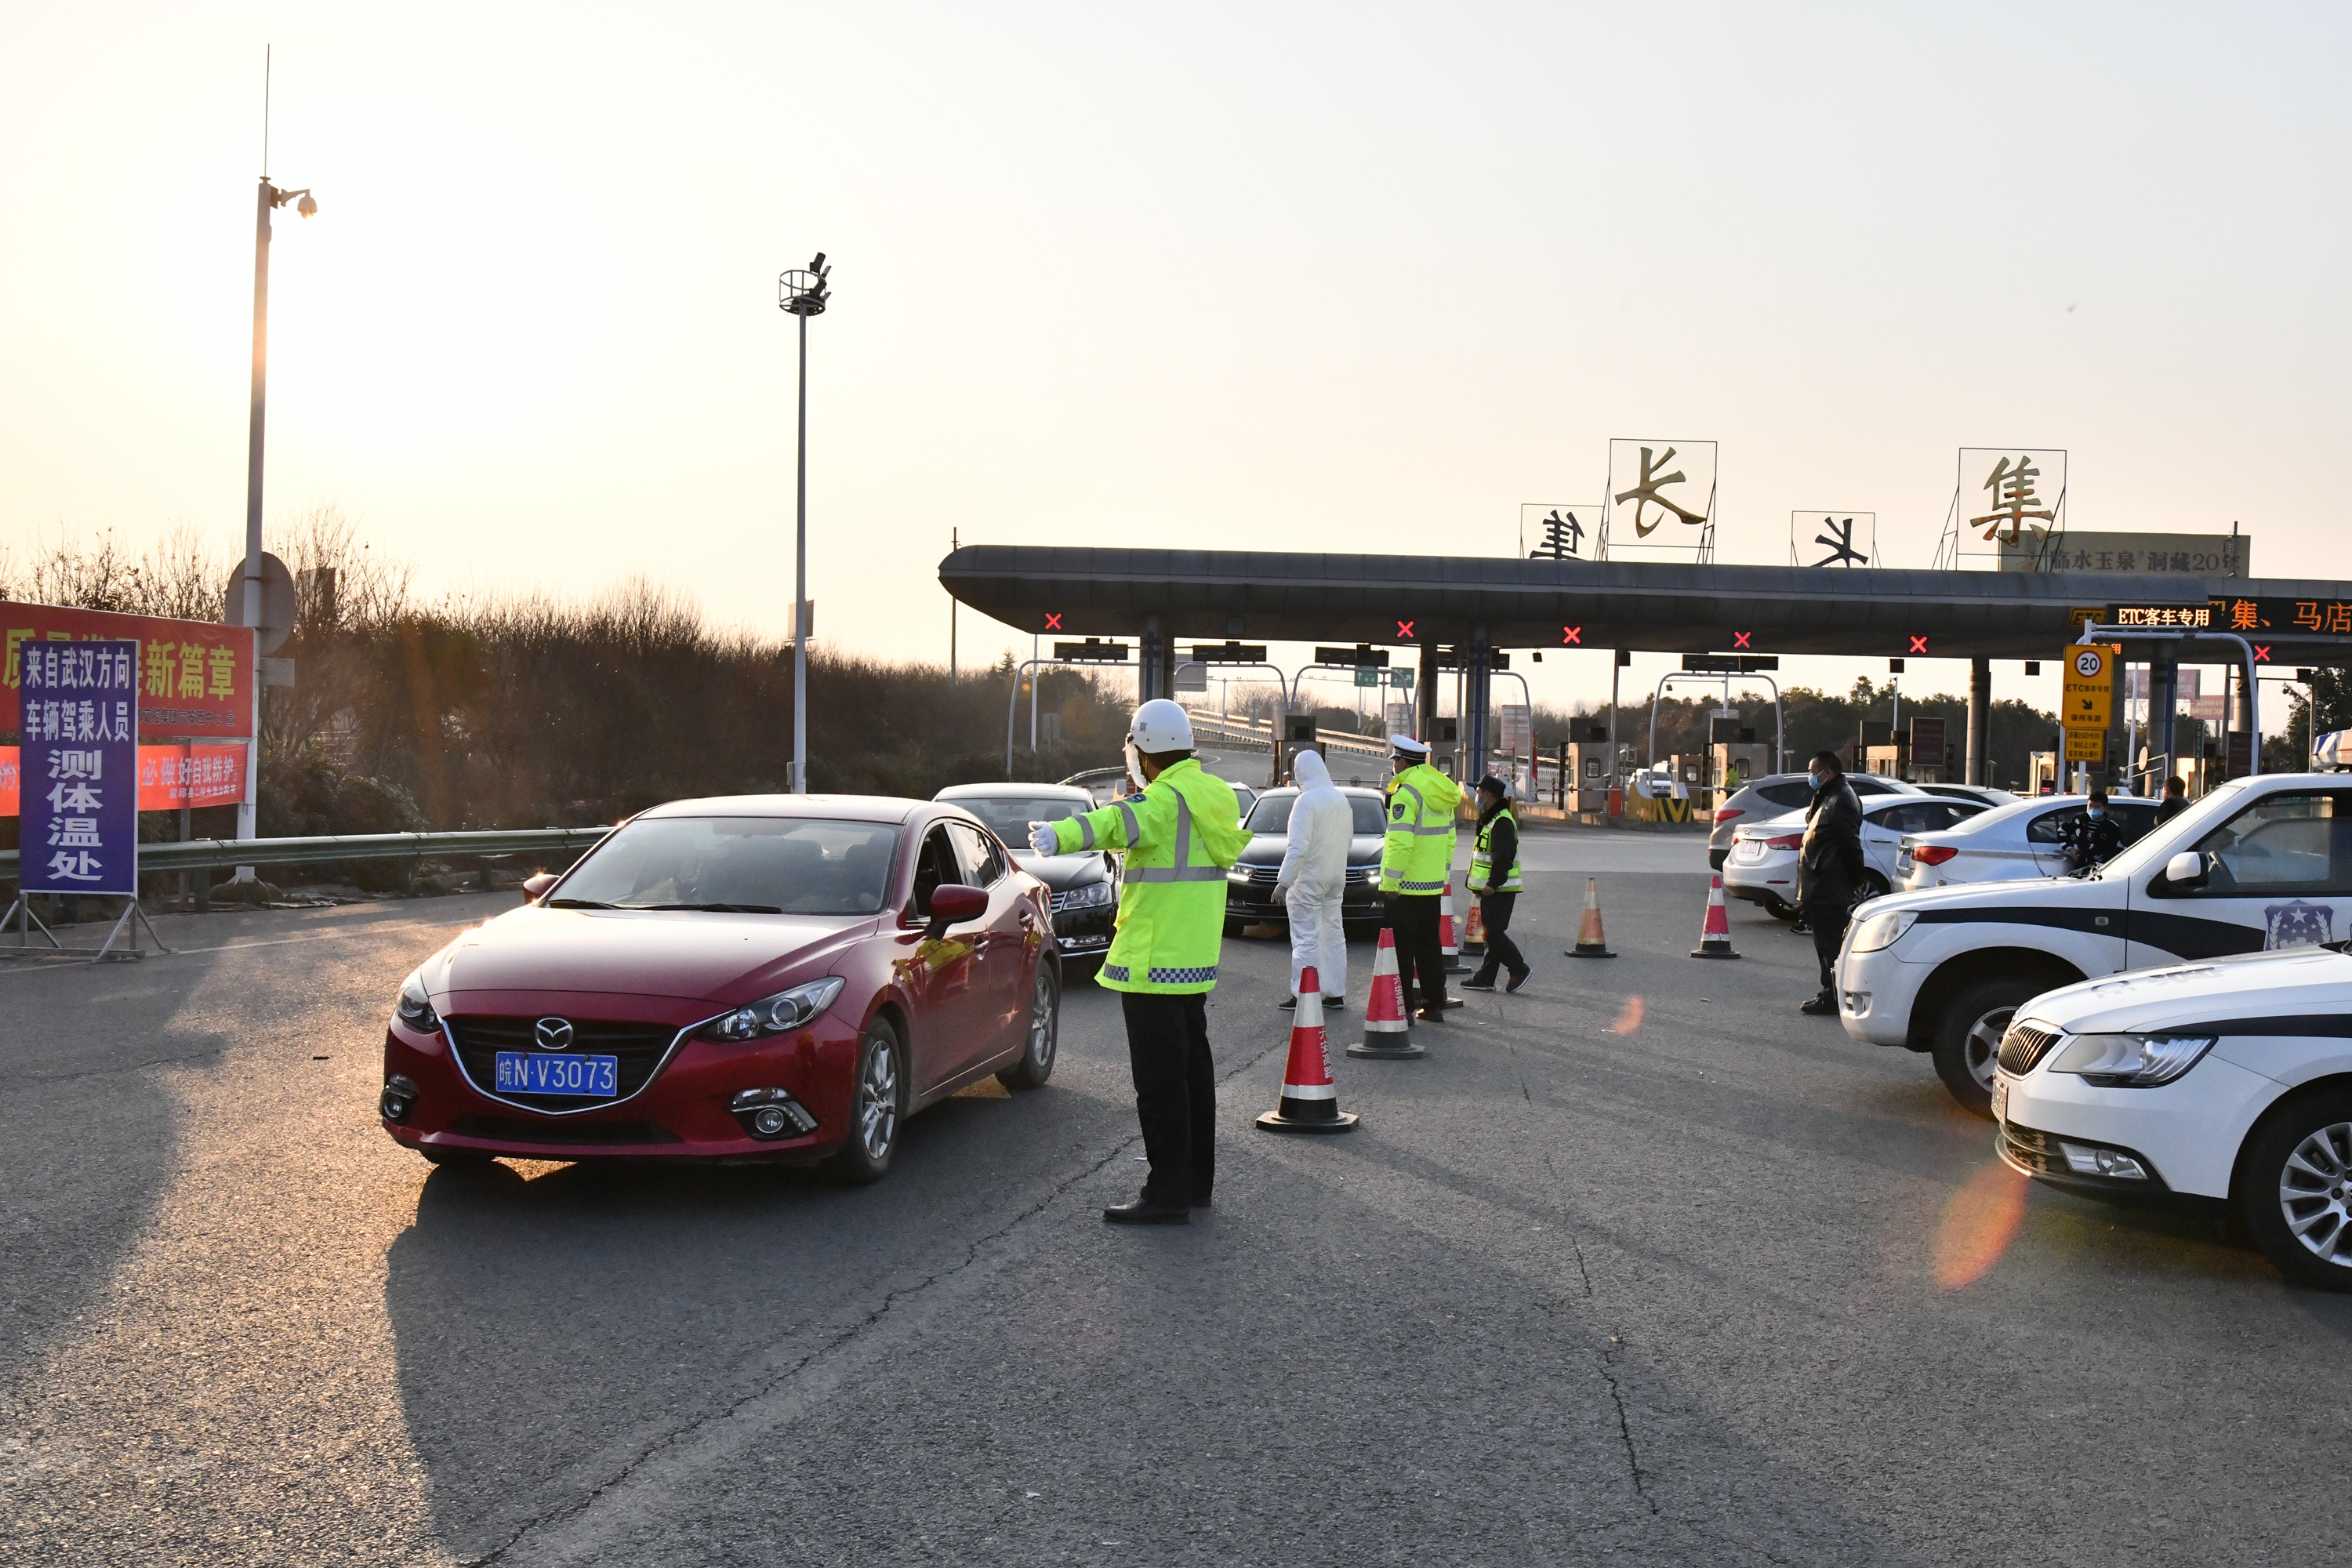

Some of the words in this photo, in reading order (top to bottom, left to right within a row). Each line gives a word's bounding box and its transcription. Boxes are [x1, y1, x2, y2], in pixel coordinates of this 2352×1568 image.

[1615, 446, 1707, 539] 长
[1969, 455, 2055, 546] 集
[2118, 608, 2210, 626] ETC客车专用
[26, 646, 129, 689] 来自武汉方向
[2080, 657, 2098, 670] 20
[2066, 684, 2109, 692] ETC客车专用
[26, 699, 129, 742] 车辆驾乘人员
[46, 749, 103, 881] 测体温处
